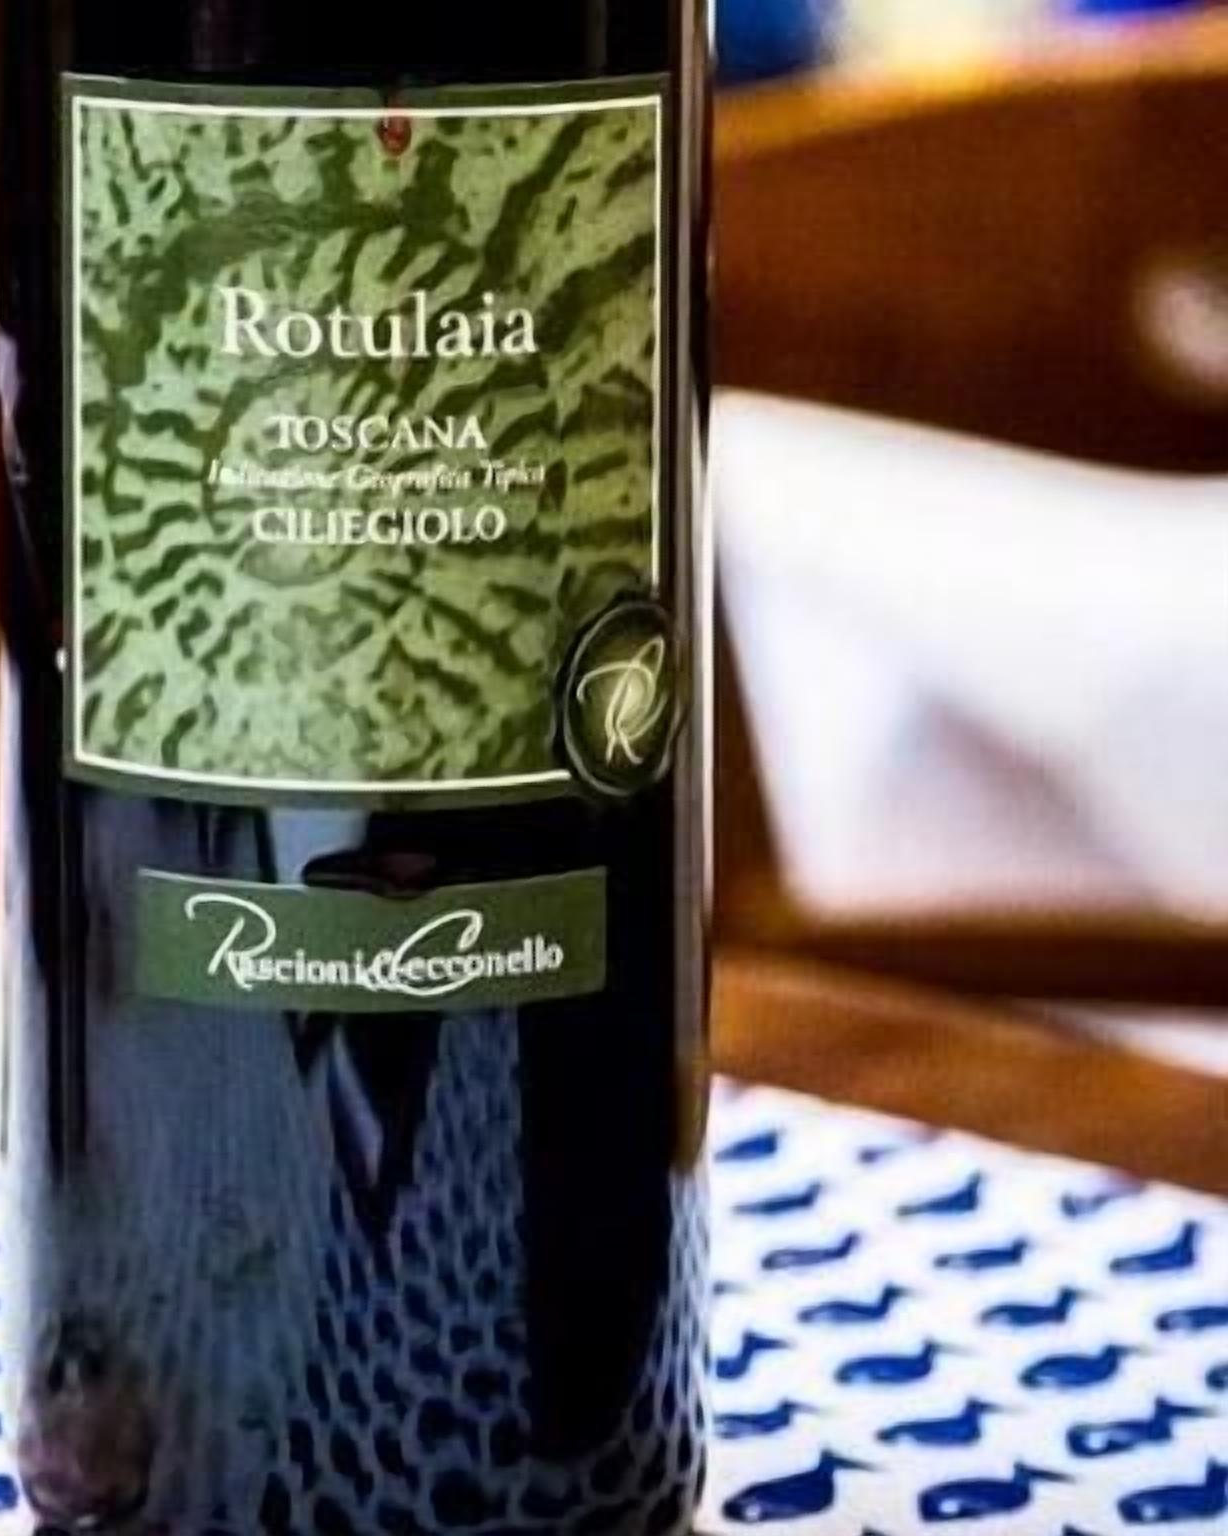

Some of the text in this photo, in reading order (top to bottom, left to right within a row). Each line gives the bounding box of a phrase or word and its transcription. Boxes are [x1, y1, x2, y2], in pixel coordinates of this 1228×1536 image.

[218, 284, 539, 358] Rotulaia
[268, 415, 488, 451] TOSCANA
[252, 505, 508, 546] CILIEGIOLO
